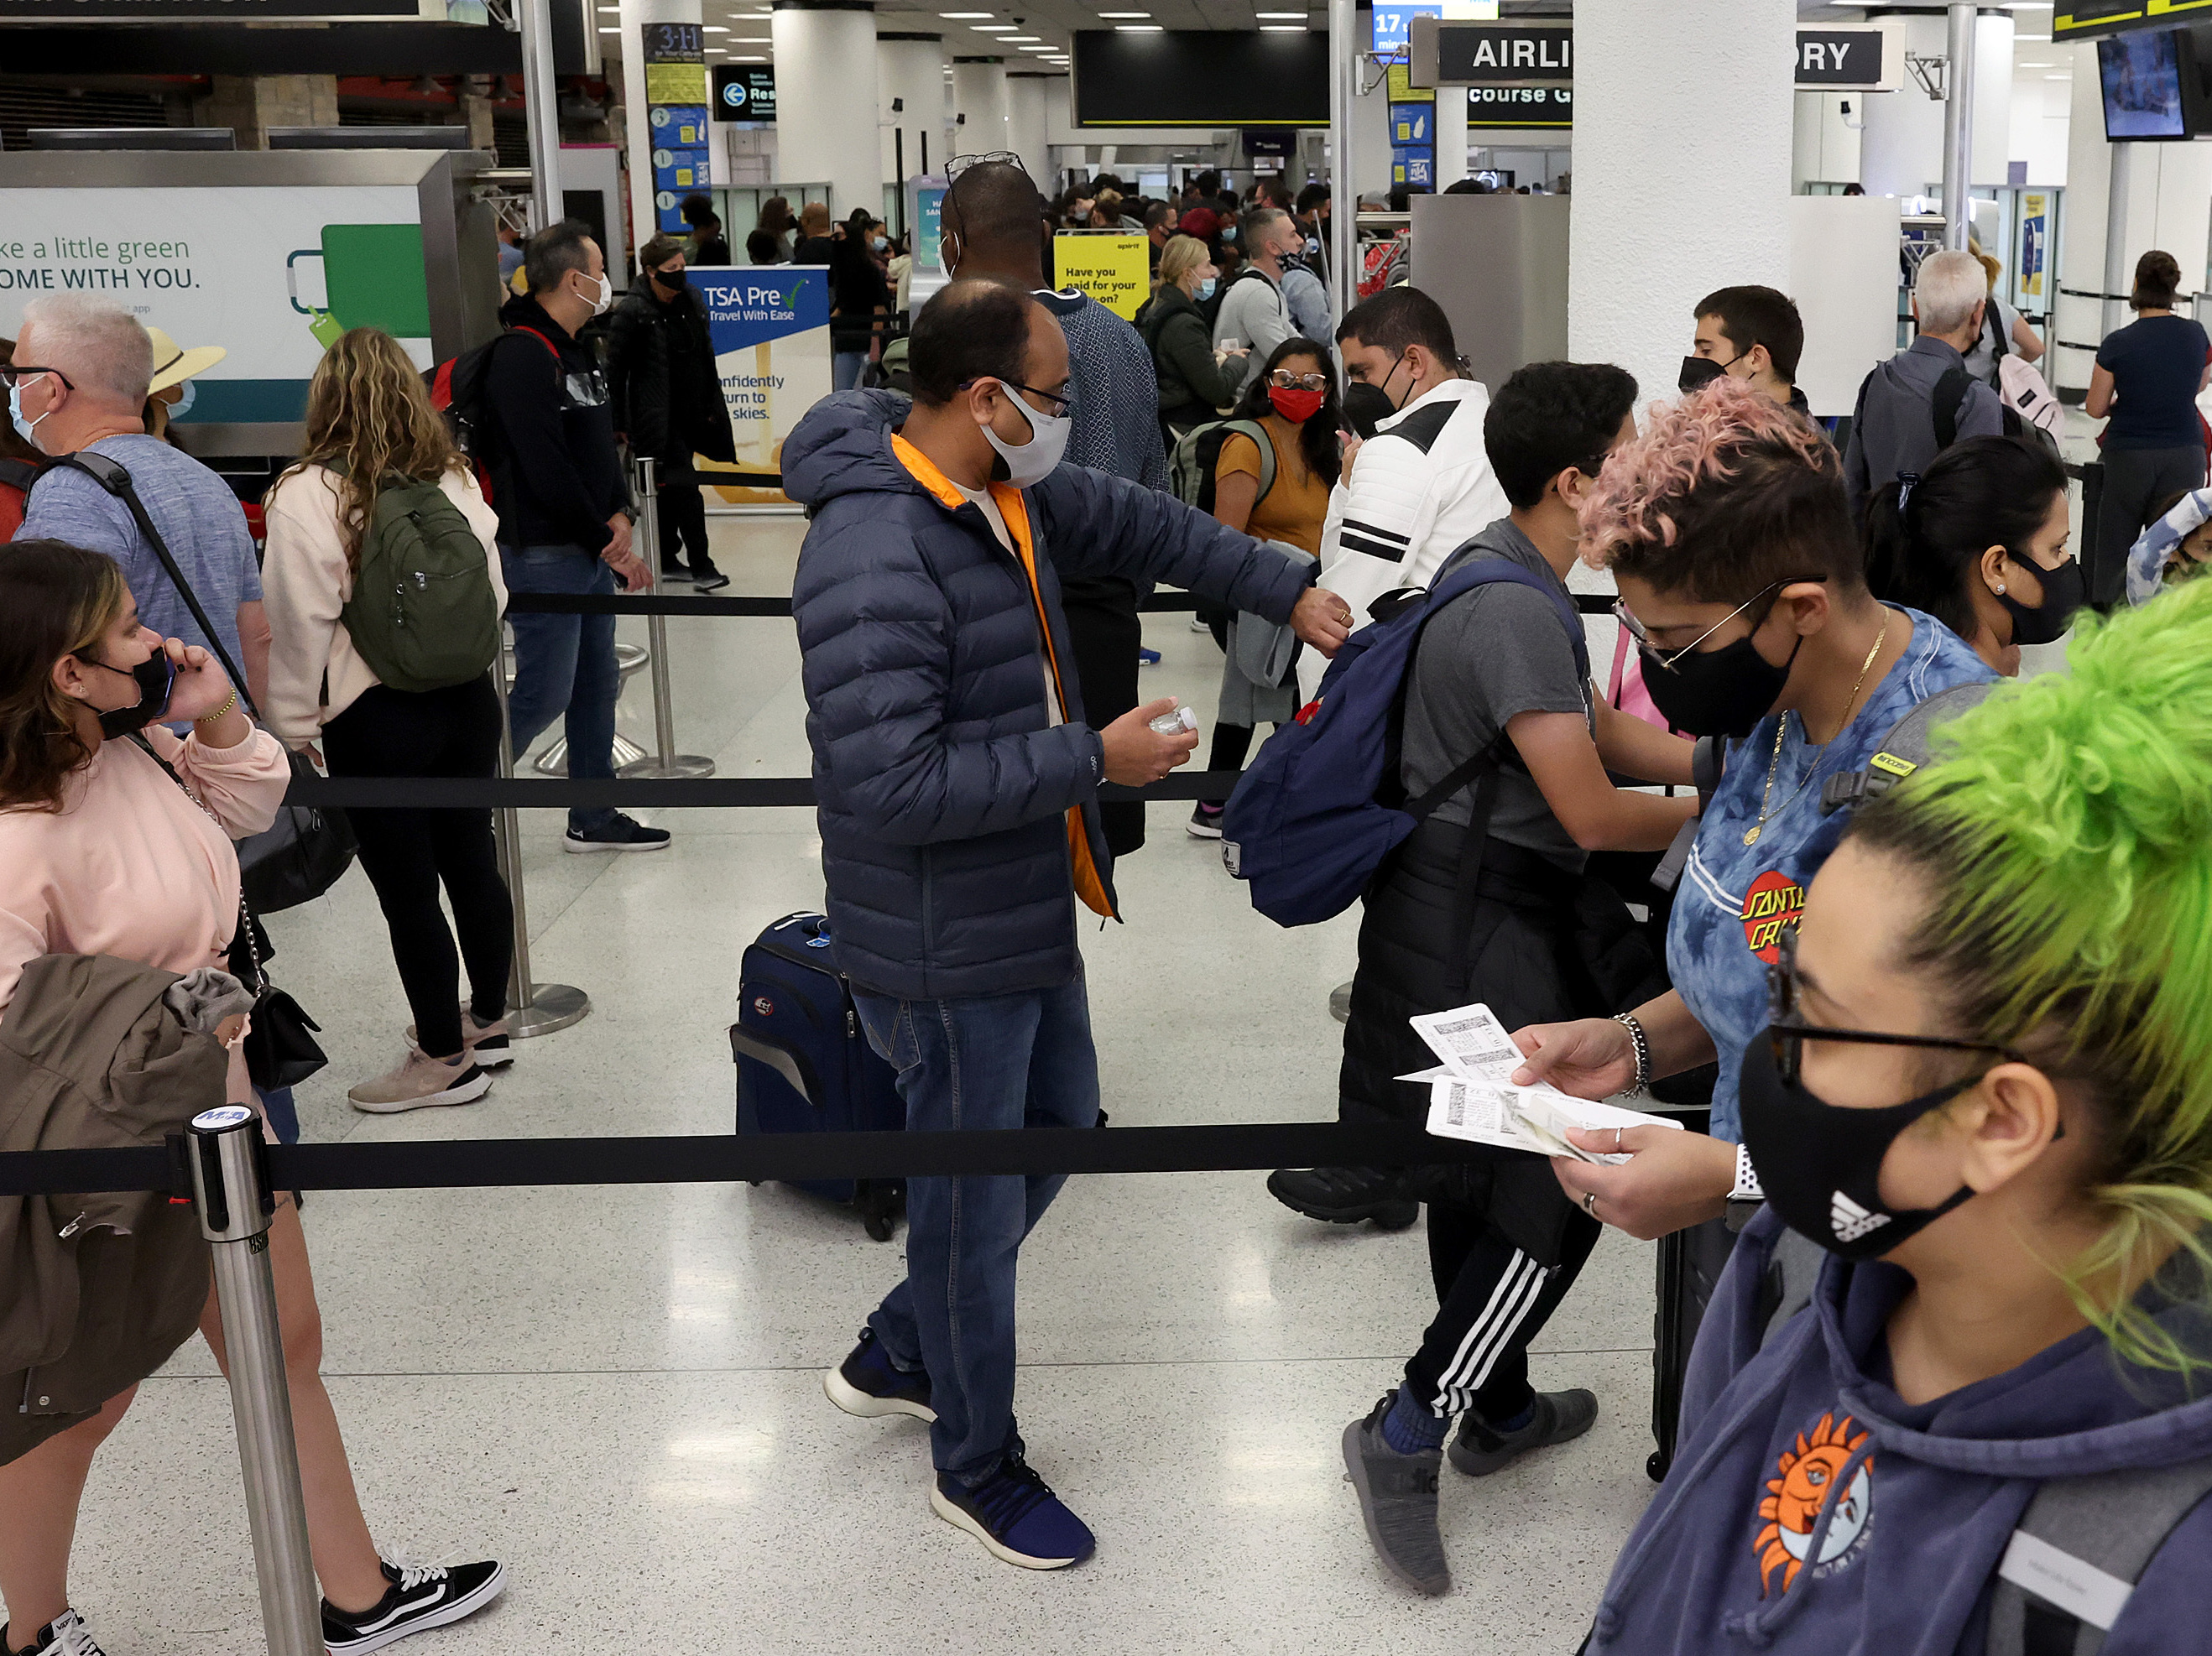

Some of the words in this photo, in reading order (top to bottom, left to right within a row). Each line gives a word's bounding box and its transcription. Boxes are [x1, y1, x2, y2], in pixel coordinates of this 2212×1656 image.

[1376, 14, 1401, 33] 17
[1473, 39, 1569, 67] AIRLI
[1469, 88, 1547, 102] course
[34, 242, 46, 258] a
[55, 237, 109, 258] little
[118, 242, 190, 264] green
[0, 268, 55, 289] OME
[60, 268, 129, 289] WITH
[136, 268, 201, 289] YOU.
[1066, 268, 1093, 277] Have
[1096, 268, 1116, 279] you
[1066, 280, 1090, 290] paid
[1093, 280, 1109, 290] for
[1111, 282, 1137, 292] your
[704, 286, 743, 306] TSA
[747, 286, 780, 306] Pre
[1093, 294, 1119, 304] -on?
[133, 305, 151, 314] app
[710, 310, 741, 321] Travel
[743, 310, 768, 321] With
[770, 310, 795, 321] Ease
[752, 391, 766, 404] to
[733, 406, 770, 419] skies.
[55, 1617, 76, 1631] VA
